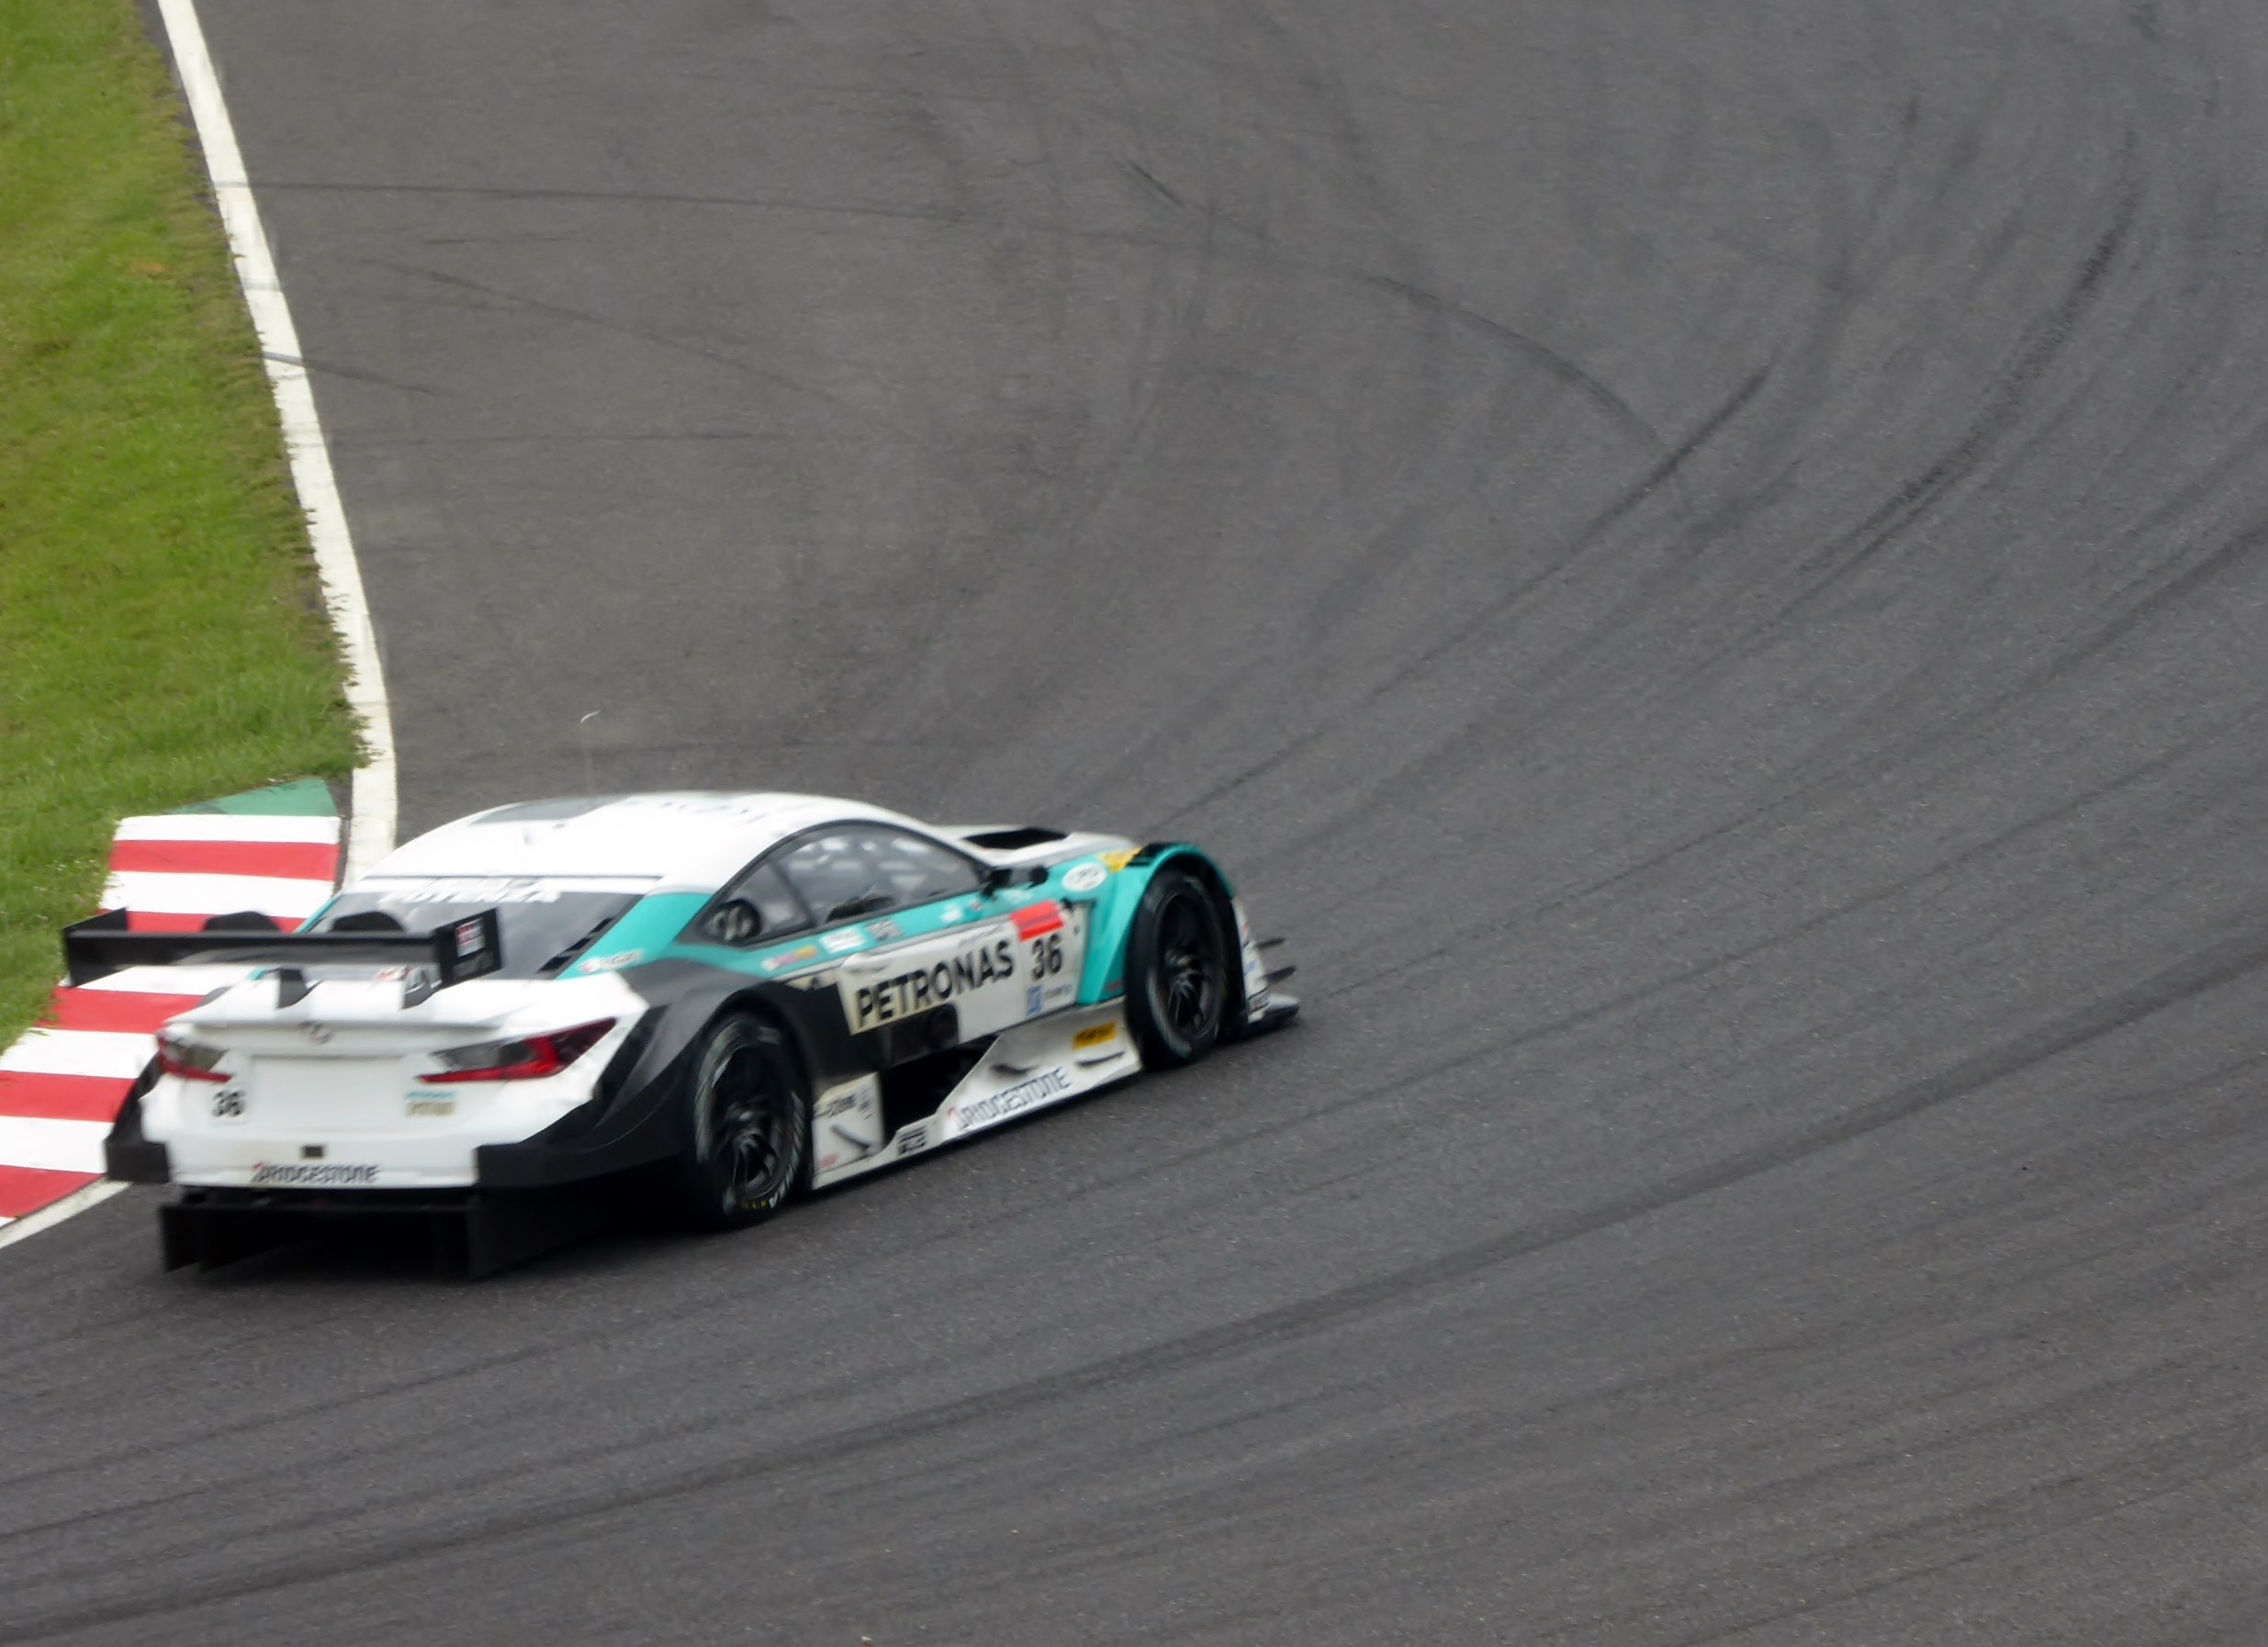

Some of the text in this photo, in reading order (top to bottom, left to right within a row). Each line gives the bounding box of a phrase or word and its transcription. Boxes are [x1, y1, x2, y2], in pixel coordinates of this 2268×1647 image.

[1030, 933, 1064, 981] 36
[856, 939, 1015, 1027] PETRONAS
[211, 1090, 246, 1118] 36
[251, 1162, 381, 1184] BRIDGESTONE
